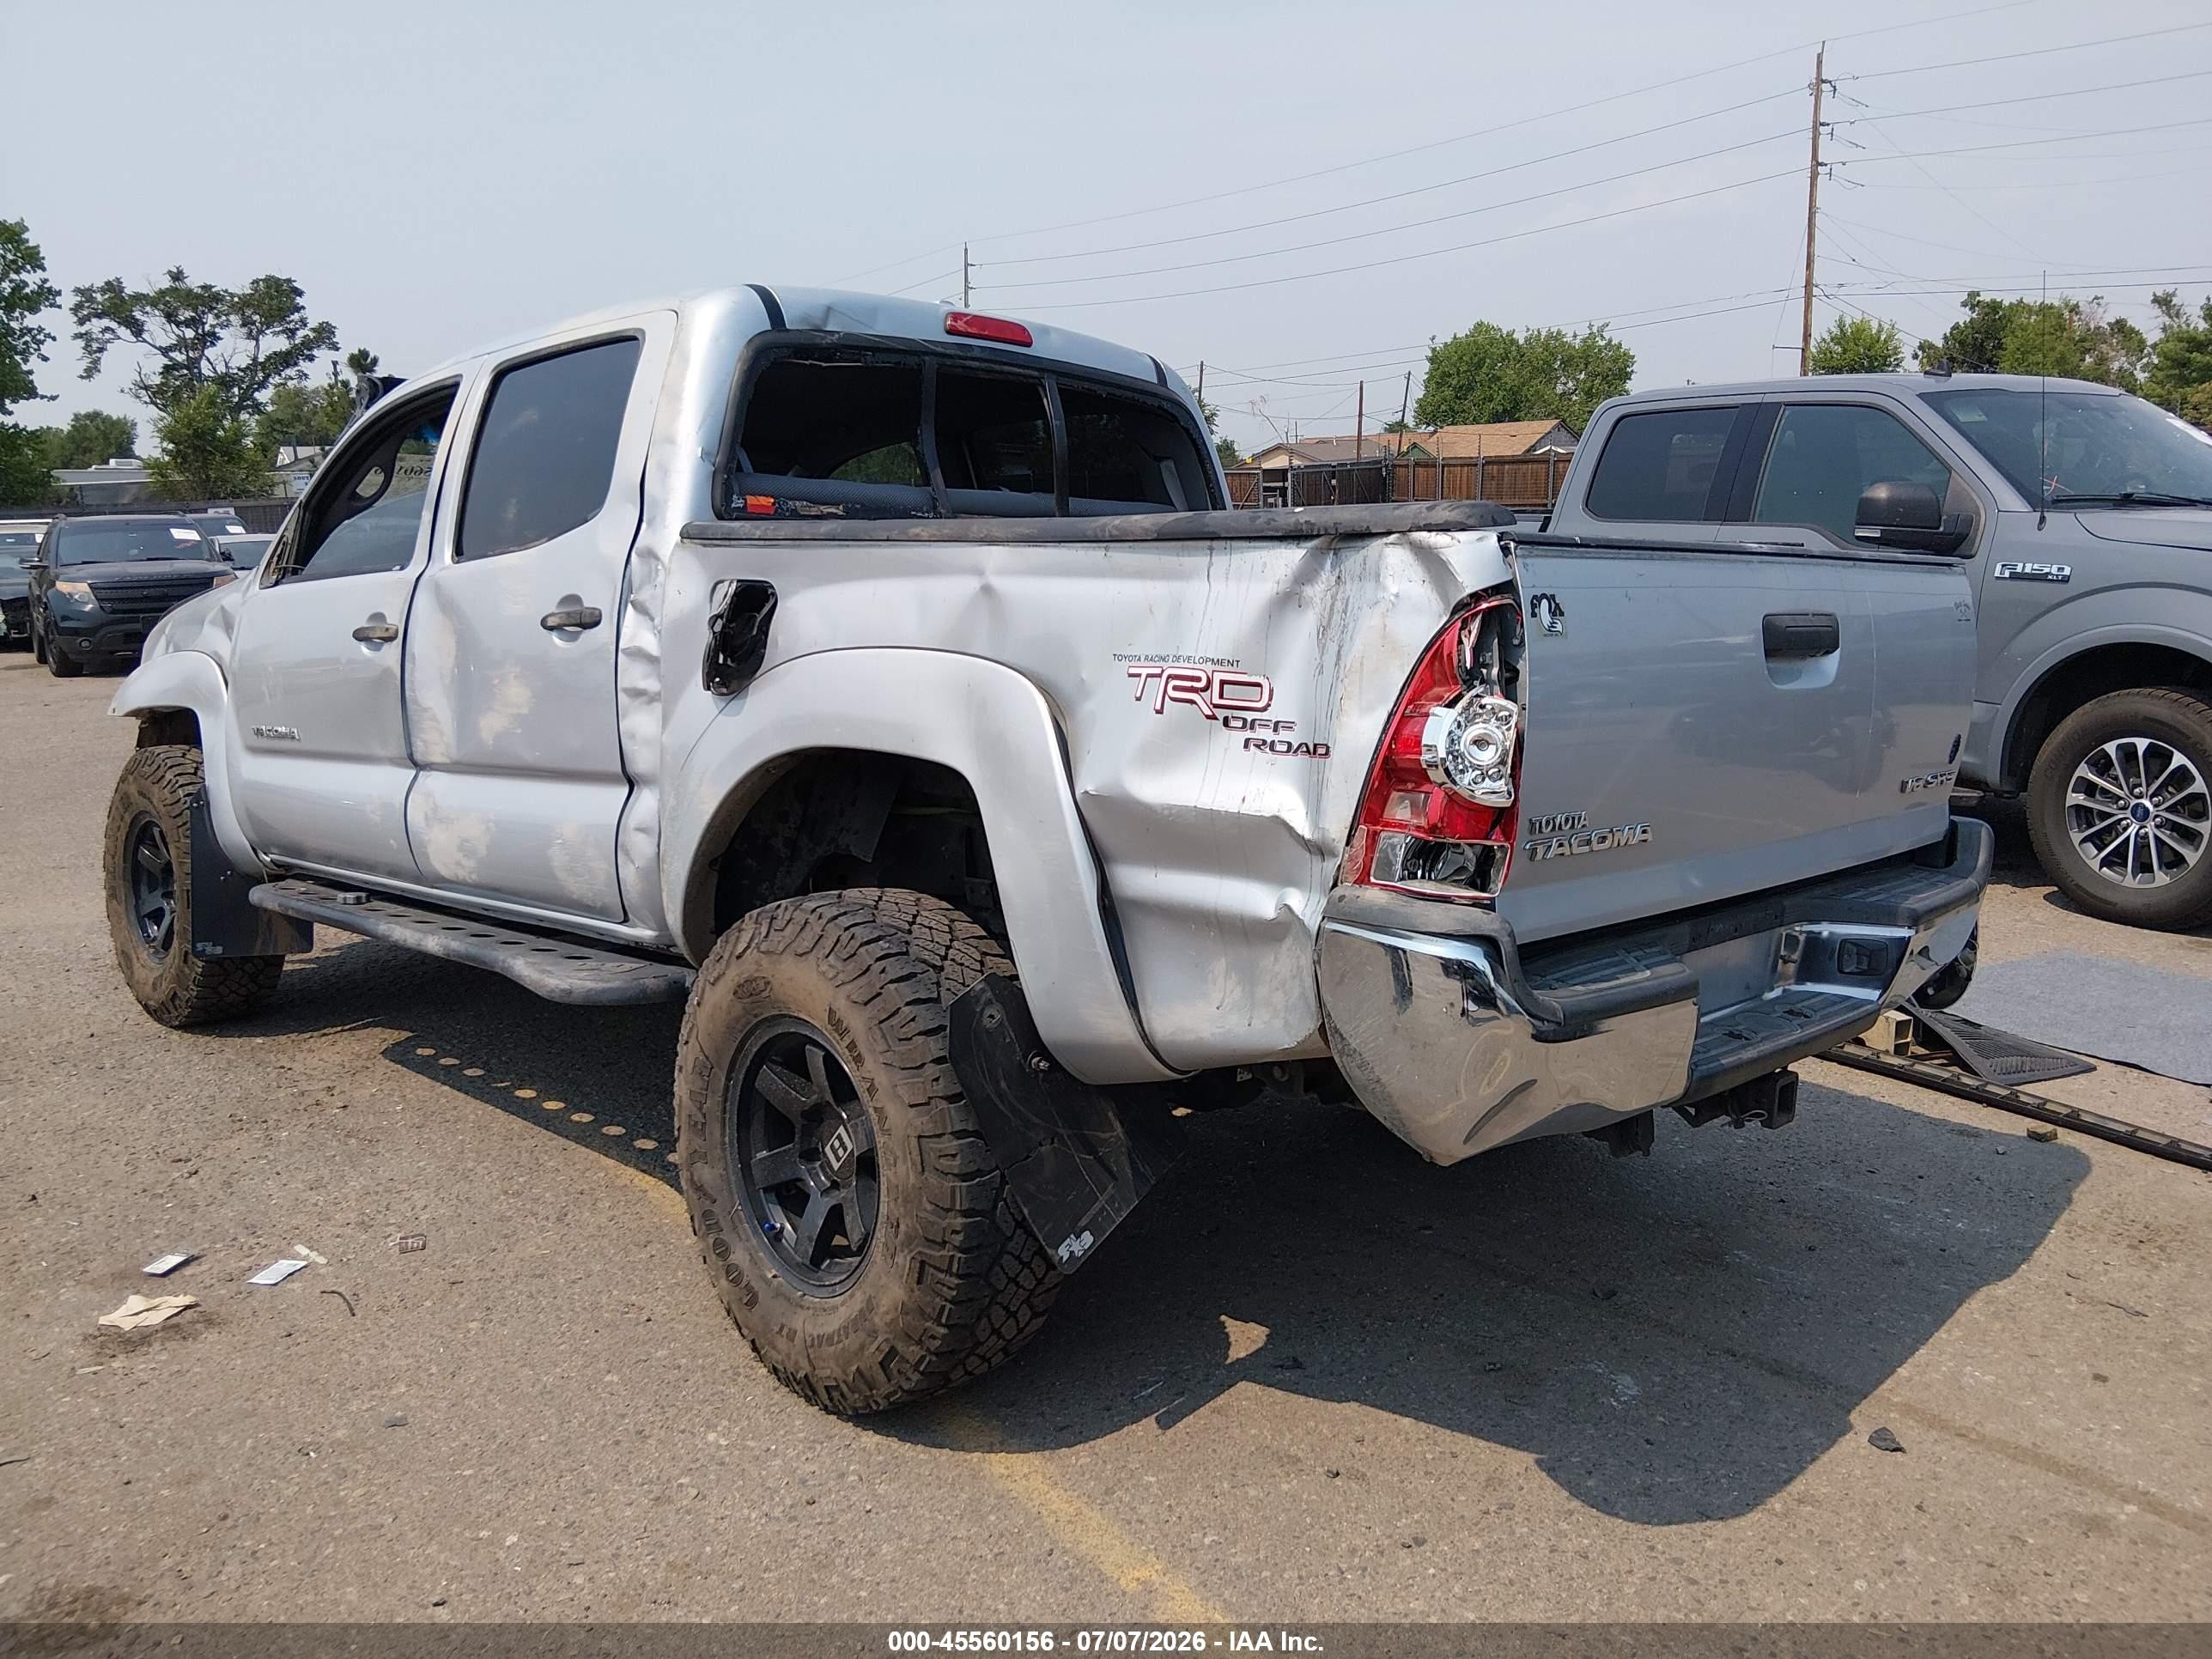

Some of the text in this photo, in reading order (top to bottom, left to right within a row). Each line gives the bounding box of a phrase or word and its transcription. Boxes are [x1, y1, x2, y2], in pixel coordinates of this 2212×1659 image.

[1112, 653, 1242, 668] TOYOTA RACING DEVELOPMENT
[1127, 665, 1274, 720] TRD
[1222, 714, 1297, 736] OFF
[1243, 737, 1334, 760] ROAD
[1528, 811, 1589, 836] TOYOTA
[1522, 823, 1653, 861] TACOMA
